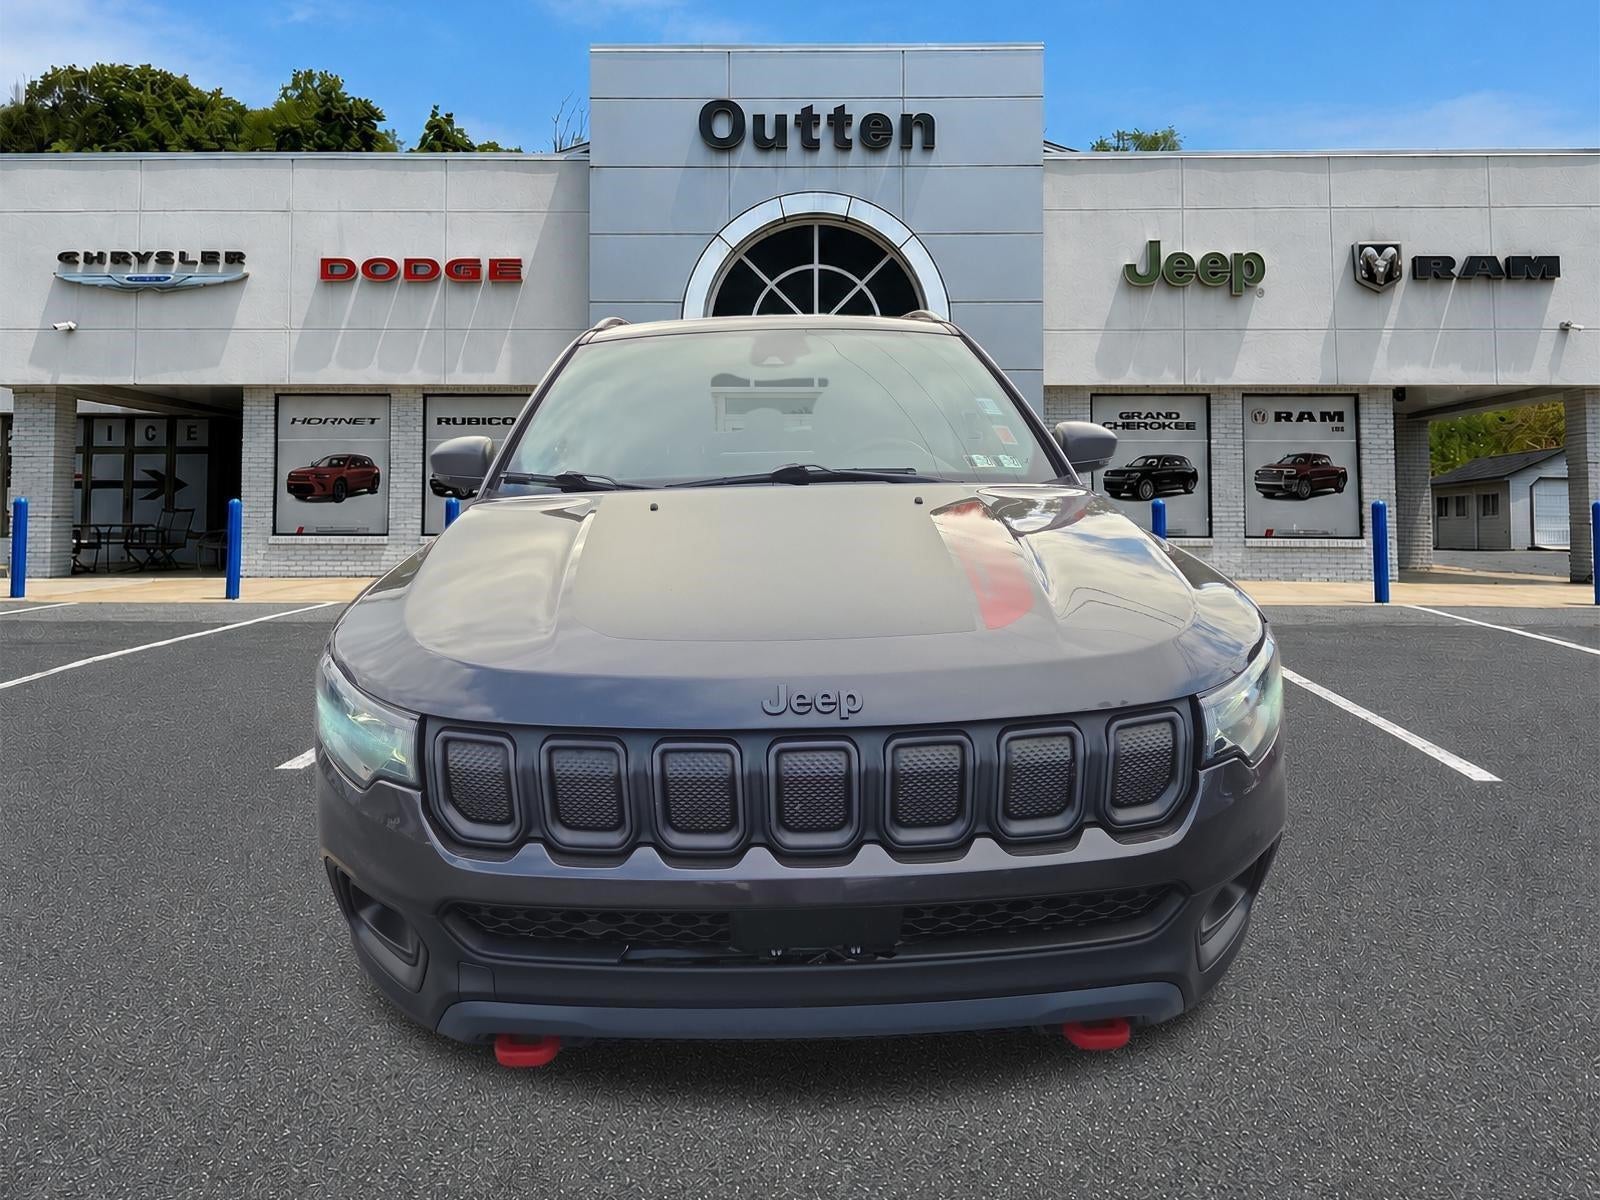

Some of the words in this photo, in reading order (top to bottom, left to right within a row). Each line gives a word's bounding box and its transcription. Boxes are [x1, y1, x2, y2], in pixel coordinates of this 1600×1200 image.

[699, 99, 936, 150] Outten
[57, 250, 246, 266] CHRYSLER
[1123, 239, 1266, 297] Jeep
[1411, 255, 1561, 280] RAM
[319, 257, 523, 283] DODGE
[290, 417, 381, 426] HORNET
[1118, 411, 1180, 420] GRAND
[1274, 411, 1345, 423] RAM
[1101, 421, 1197, 431] CHEROKEE
[760, 683, 864, 721] Jeep
